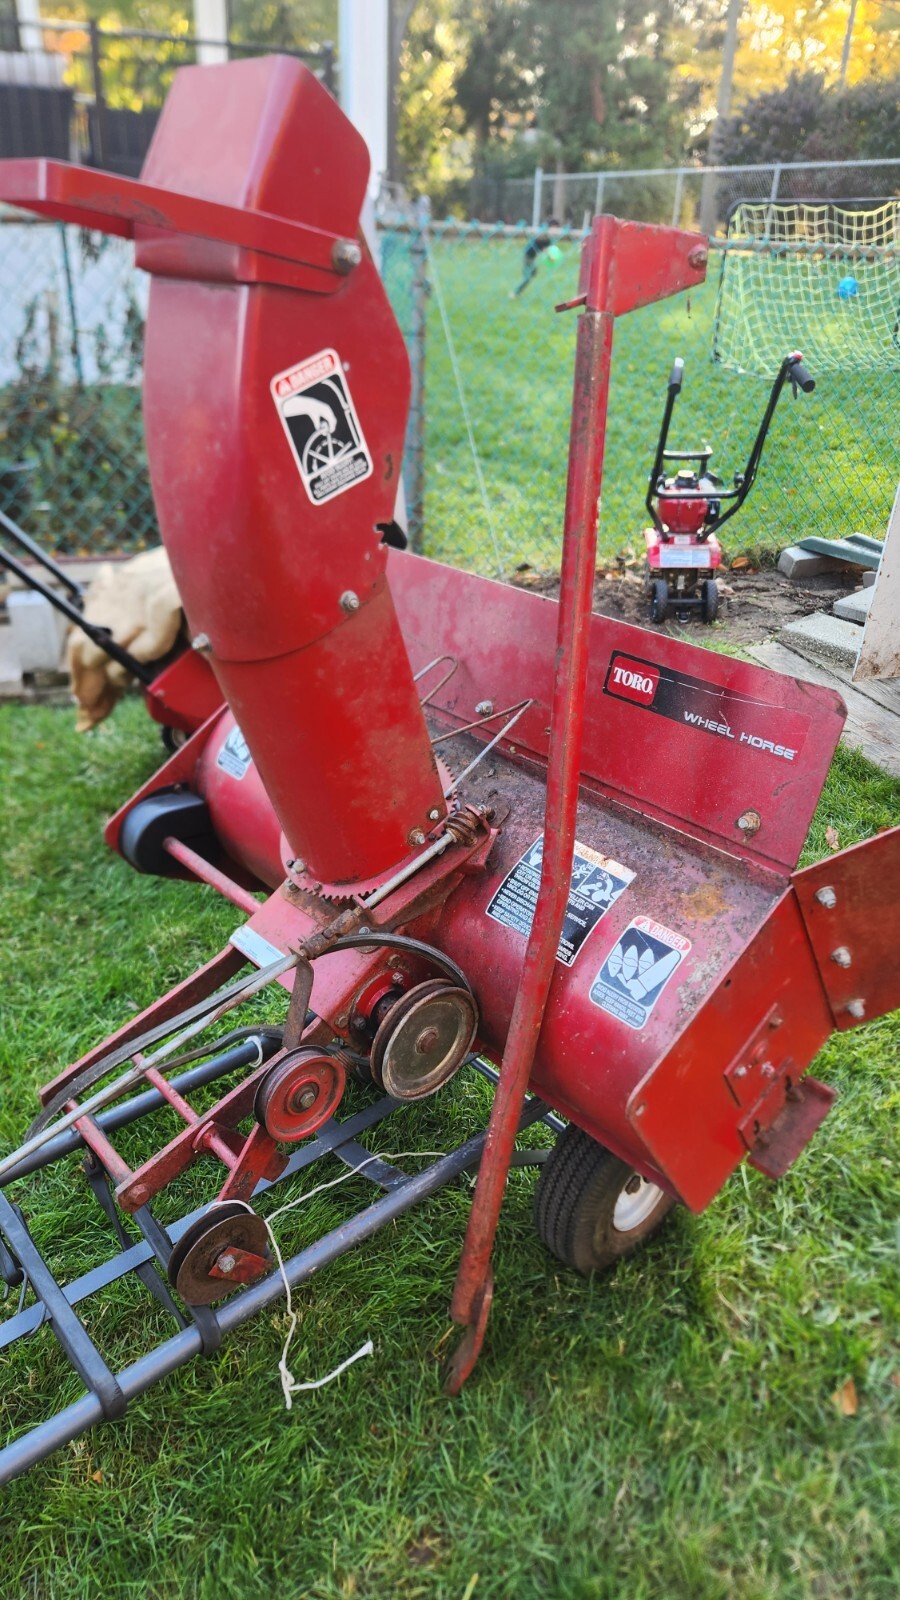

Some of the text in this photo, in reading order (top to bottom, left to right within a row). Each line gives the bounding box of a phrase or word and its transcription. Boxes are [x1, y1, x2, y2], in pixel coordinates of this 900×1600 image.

[684, 711, 797, 760] WHEEL HORSE
[649, 923, 686, 950] DANGER
